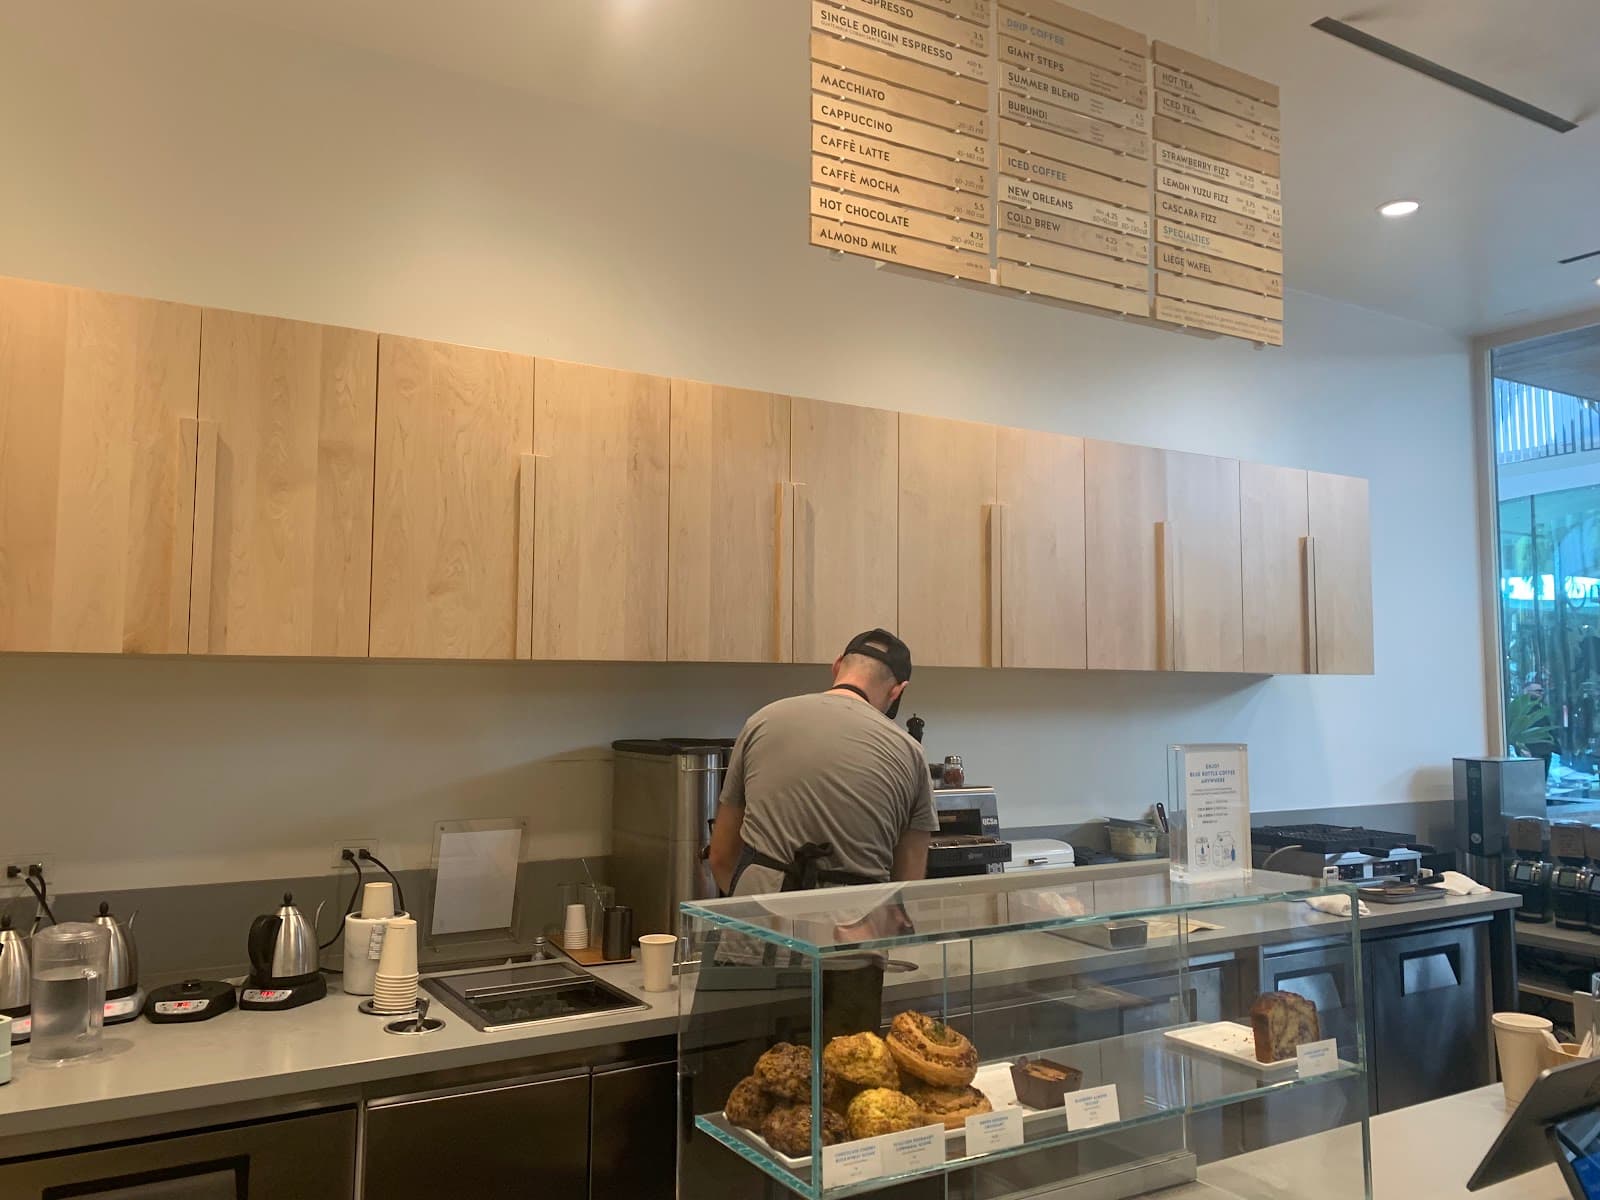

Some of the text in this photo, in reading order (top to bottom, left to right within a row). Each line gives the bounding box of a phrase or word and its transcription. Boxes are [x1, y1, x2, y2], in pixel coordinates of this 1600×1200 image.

[820, 10, 859, 31] SINGLE
[862, 24, 899, 45] ORIGIN
[902, 37, 953, 61] ESPRESSO
[1007, 18, 1065, 46] DRIP COFFEE
[1007, 45, 1065, 73] GIANT STEPS
[820, 74, 886, 101] MACCHIATO
[1008, 72, 1049, 93] SUMMER
[1052, 86, 1080, 103] BLEND
[1162, 72, 1194, 90] HOT TEA
[821, 105, 894, 133] CAPPUCCINO
[1008, 100, 1048, 120] BURUNDI
[1163, 98, 1181, 111] ICED
[1183, 105, 1197, 116] TEA
[821, 134, 891, 162] CAFFÈ LATTE
[1008, 157, 1067, 182] ICED COFFEE
[1162, 149, 1212, 170] STRAWBERRY
[1213, 165, 1230, 178] FIZZ
[820, 165, 901, 194] CAFFÈ MOCHA
[1162, 177, 1229, 204] LEMON YUZU FIZZ
[1008, 185, 1030, 199] NEW
[1033, 191, 1074, 210] ORLEANS
[819, 197, 910, 228] HOT CHOCOLATE
[1007, 211, 1032, 226] COLD
[1035, 218, 1062, 232] BREW
[1162, 201, 1217, 224] CASCARA FIZZ
[820, 229, 898, 255] ALMOND MILK
[1163, 225, 1211, 246] SPECIALTIES
[1187, 260, 1213, 274] WAFEL
